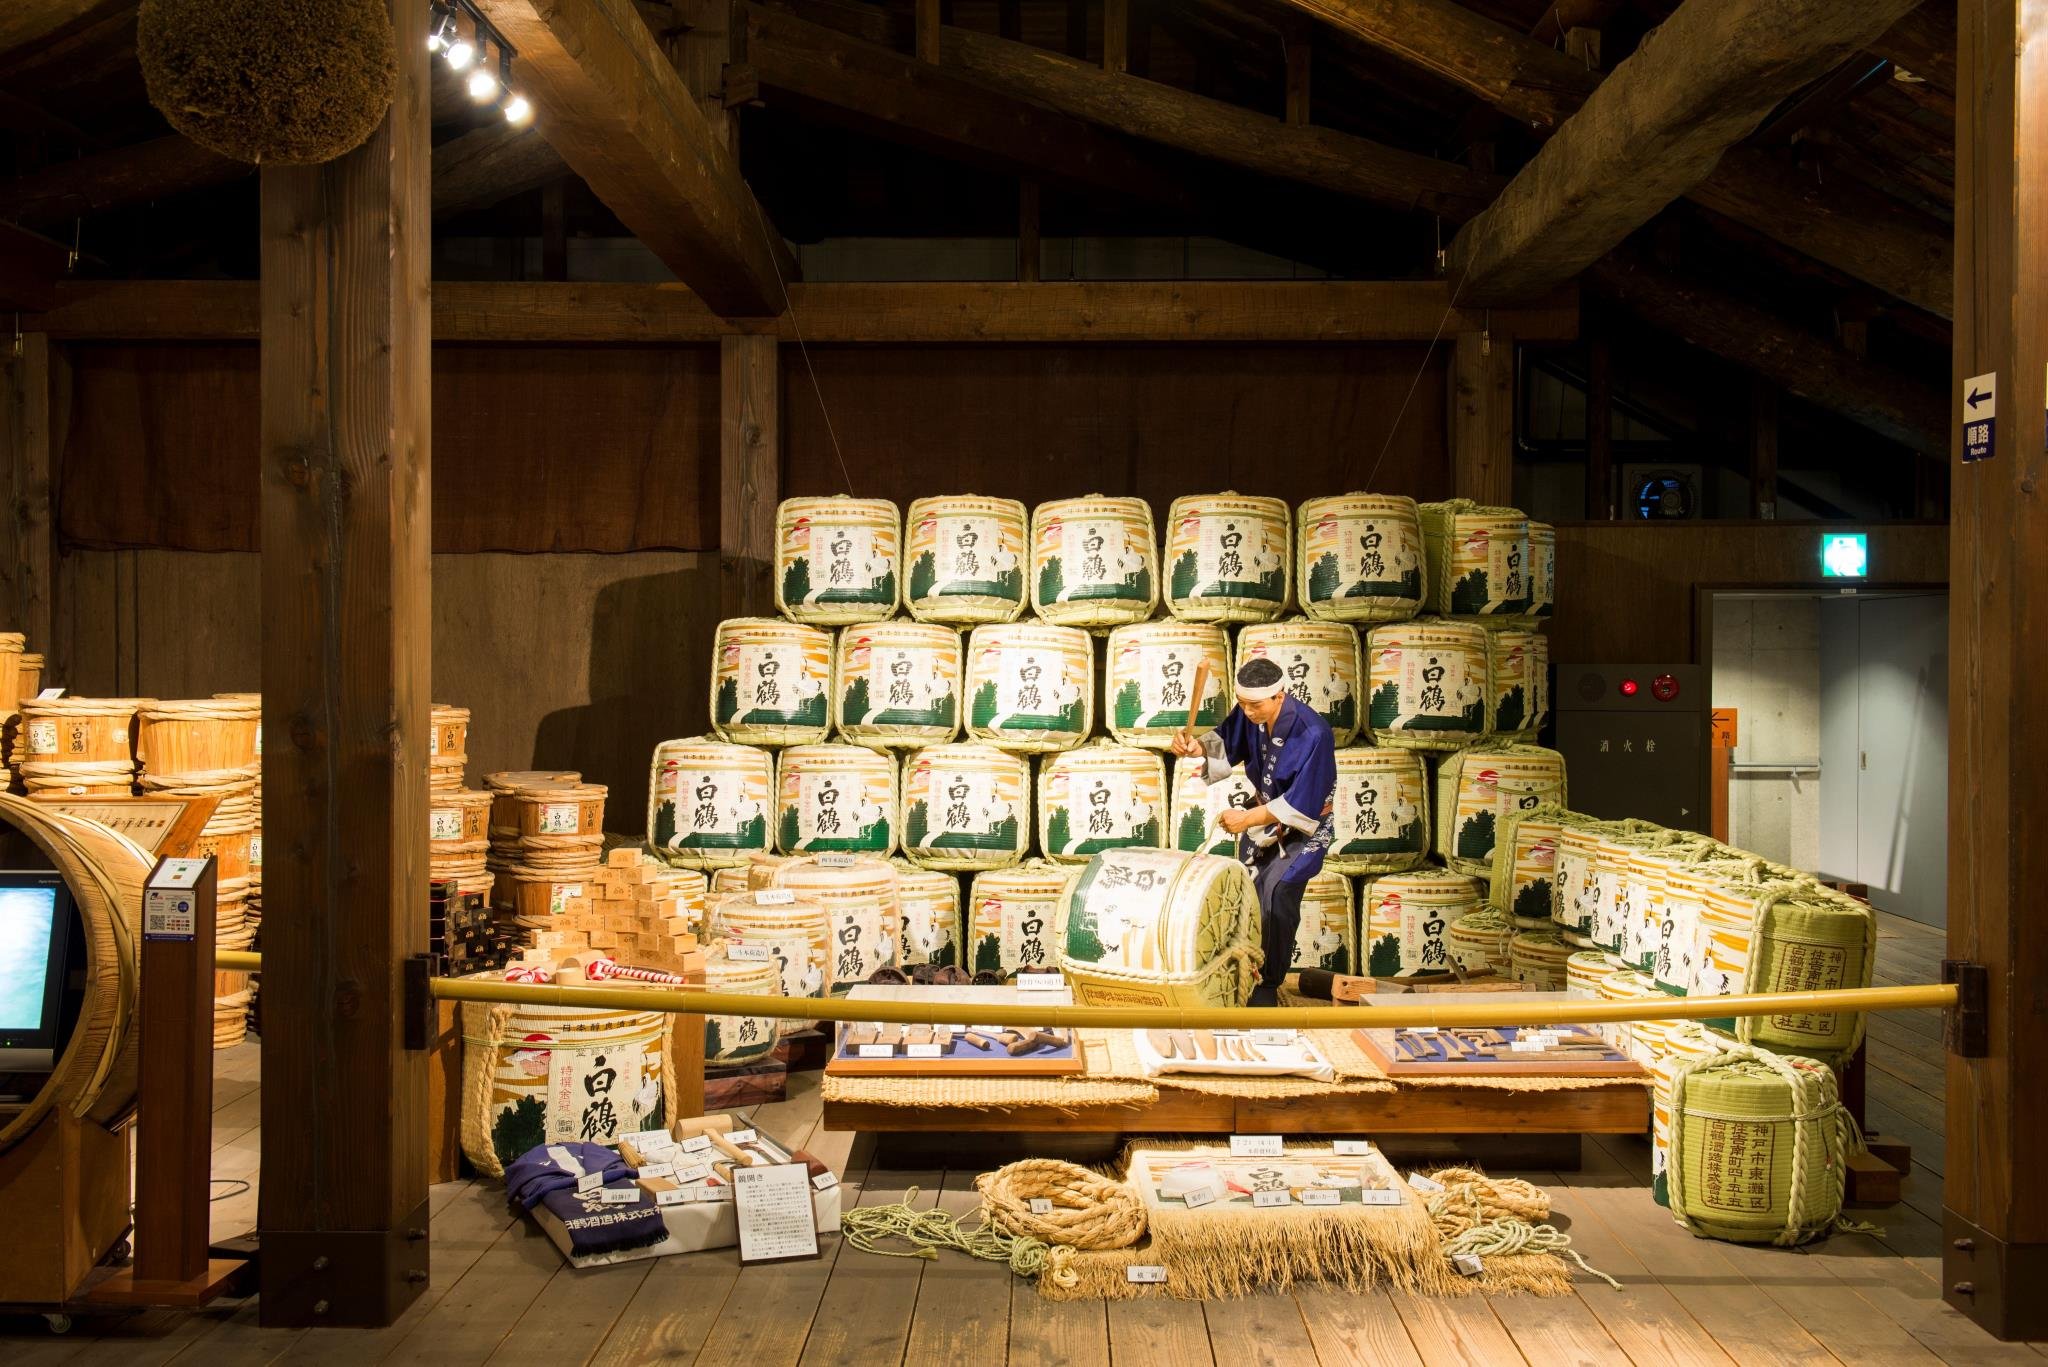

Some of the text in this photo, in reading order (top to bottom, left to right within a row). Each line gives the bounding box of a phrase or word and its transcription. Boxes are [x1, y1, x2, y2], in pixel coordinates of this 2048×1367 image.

[830, 531, 854, 584] 白鶴
[955, 524, 979, 576] 白鶴
[1082, 528, 1106, 580] 白鶴
[1218, 524, 1244, 577] 白鶴
[1360, 524, 1385, 578] 白鶴
[1506, 543, 1521, 596] 白鶴
[756, 653, 780, 705] 白鶴
[889, 652, 914, 705] 白鶴
[1017, 657, 1041, 710] 白鶴
[1161, 653, 1186, 706] 白鶴
[1419, 657, 1445, 711] 白鶴
[72, 728, 84, 752] 白鶴
[1600, 740, 1656, 753] 消火栓
[694, 776, 718, 829] 白鶴
[817, 780, 841, 834] 白鶴
[947, 775, 971, 828] 白鶴
[1089, 781, 1113, 834] 白鶴
[1355, 781, 1380, 835] 白鶴
[1099, 864, 1167, 891] 白鶴
[1555, 861, 1568, 918] 白鶴
[837, 915, 863, 978] 白鶴
[1020, 910, 1045, 966] 白鶴
[1422, 910, 1447, 966] 白鶴
[1658, 907, 1674, 977] 白鶴
[1777, 946, 1807, 1027] 白鶴酒造社
[1819, 952, 1842, 1032] 神戸市区
[580, 1054, 618, 1141] 白鶴
[1748, 1125, 1768, 1208] 神戸市東灘区
